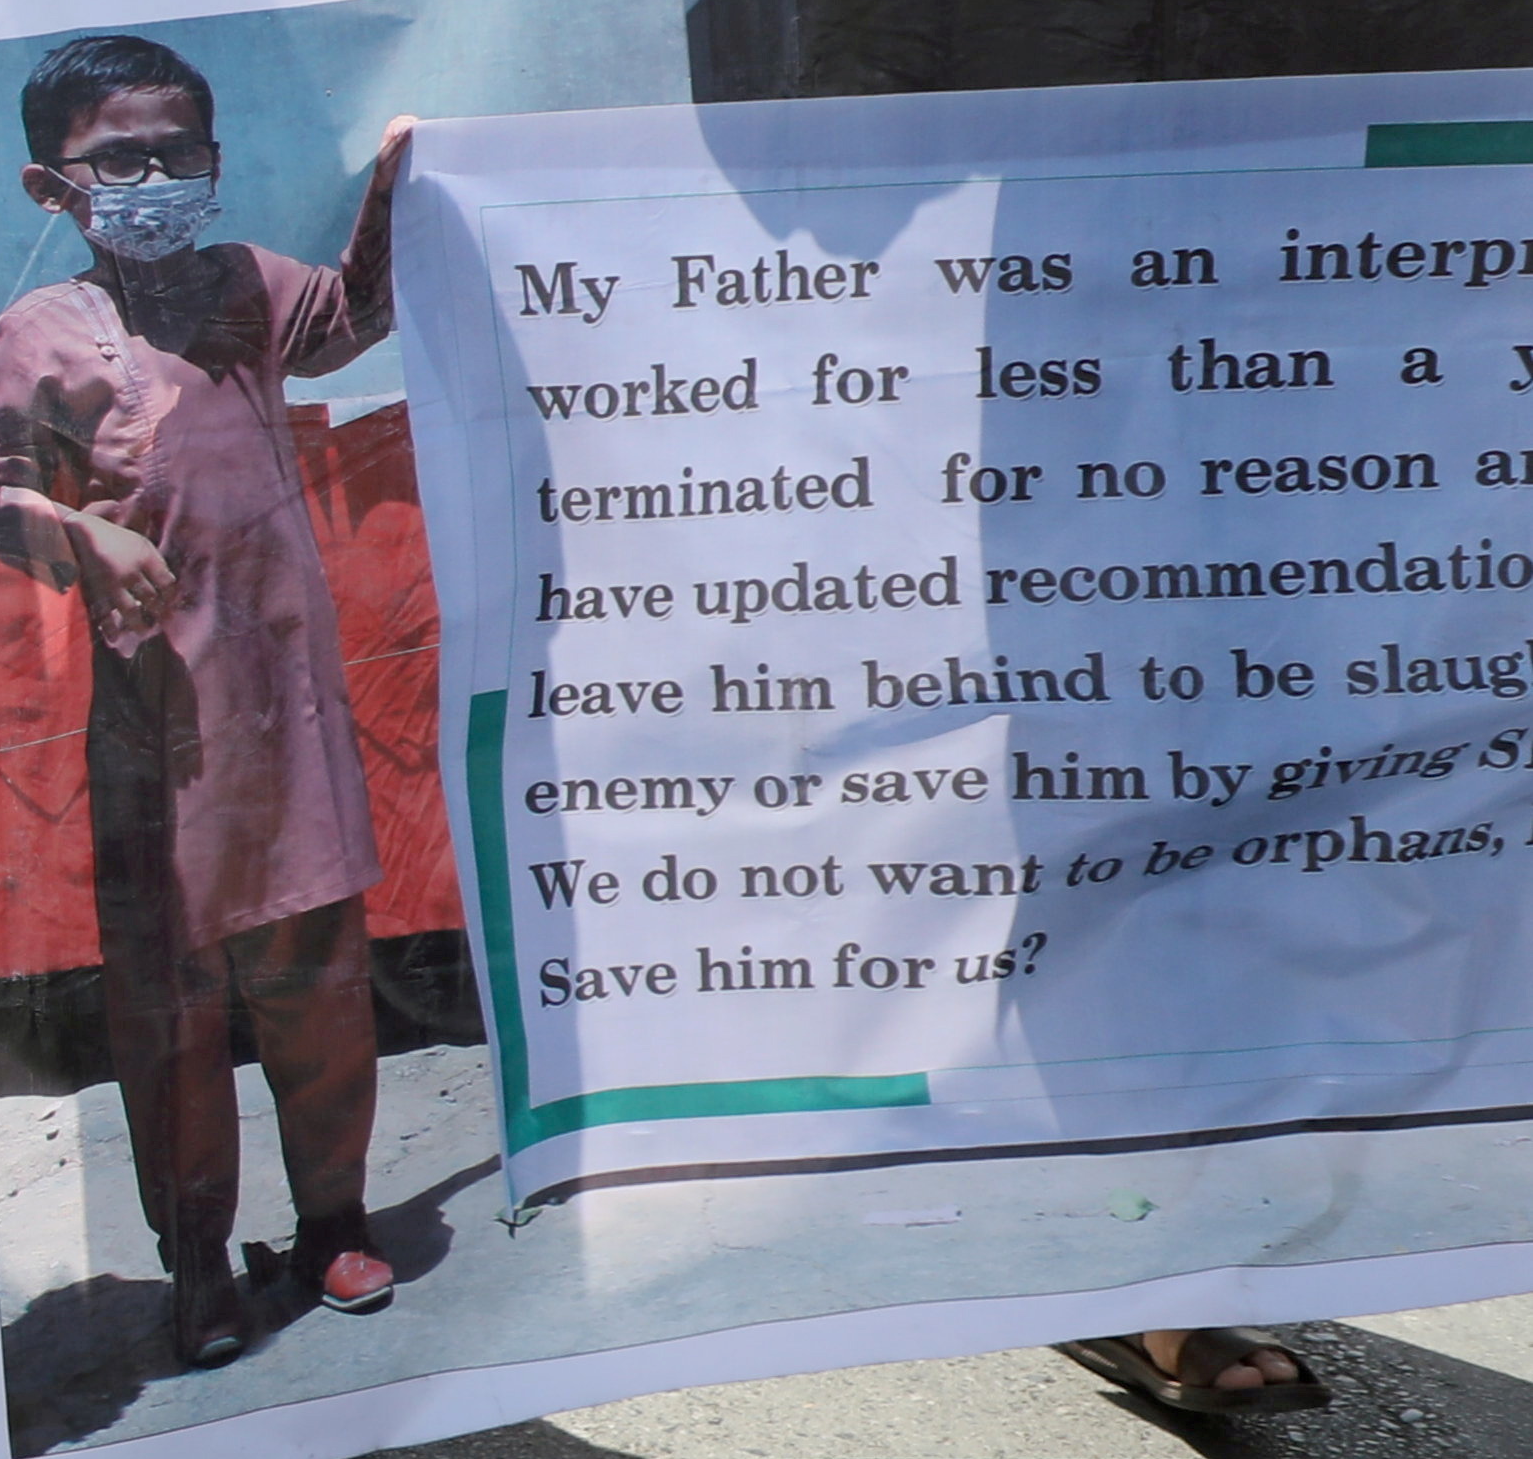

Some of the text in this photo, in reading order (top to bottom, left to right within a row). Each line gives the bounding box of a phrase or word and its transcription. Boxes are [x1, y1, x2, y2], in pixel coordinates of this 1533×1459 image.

[515, 261, 620, 324] My
[671, 250, 880, 308] Father
[935, 251, 1073, 294] was
[1131, 246, 1219, 287] an
[526, 358, 760, 421] worked
[813, 353, 909, 405] for
[976, 346, 1101, 399] less
[1167, 338, 1334, 392] than
[1401, 347, 1443, 384] a
[536, 456, 874, 523] terminated
[942, 452, 1042, 504] for
[1077, 459, 1166, 499] no
[1200, 452, 1439, 496] reason
[535, 574, 674, 622] have
[693, 556, 961, 624] updated
[528, 639, 1533, 719] leave him behind to be slaug
[525, 775, 735, 816] enemy
[753, 772, 822, 808] or
[841, 766, 988, 805] save
[1013, 751, 1150, 801] him
[1167, 750, 1252, 807] by
[1267, 742, 1471, 801] giving
[528, 860, 620, 910] We
[643, 855, 718, 901] do
[741, 855, 844, 898] not
[868, 855, 1042, 896] want
[1067, 853, 1123, 887] to
[1144, 842, 1214, 876] be
[1233, 815, 1505, 873] orphans,
[540, 933, 1047, 1007] Save him for us?
